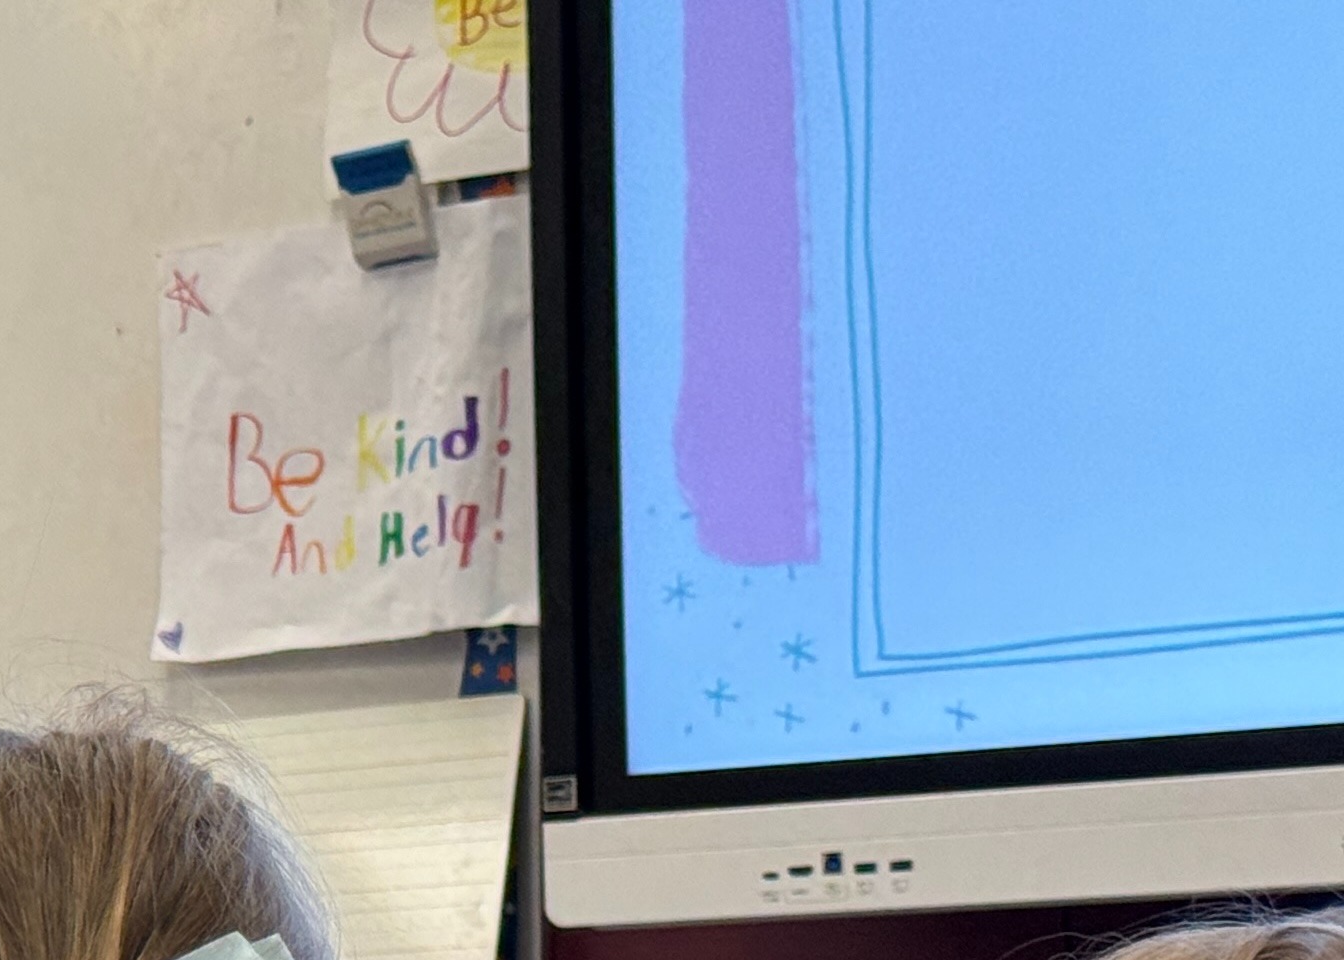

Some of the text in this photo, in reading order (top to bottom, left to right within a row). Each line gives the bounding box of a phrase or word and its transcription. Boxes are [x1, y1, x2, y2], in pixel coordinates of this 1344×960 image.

[228, 367, 511, 518] Be Kind!
[271, 514, 357, 578] And
